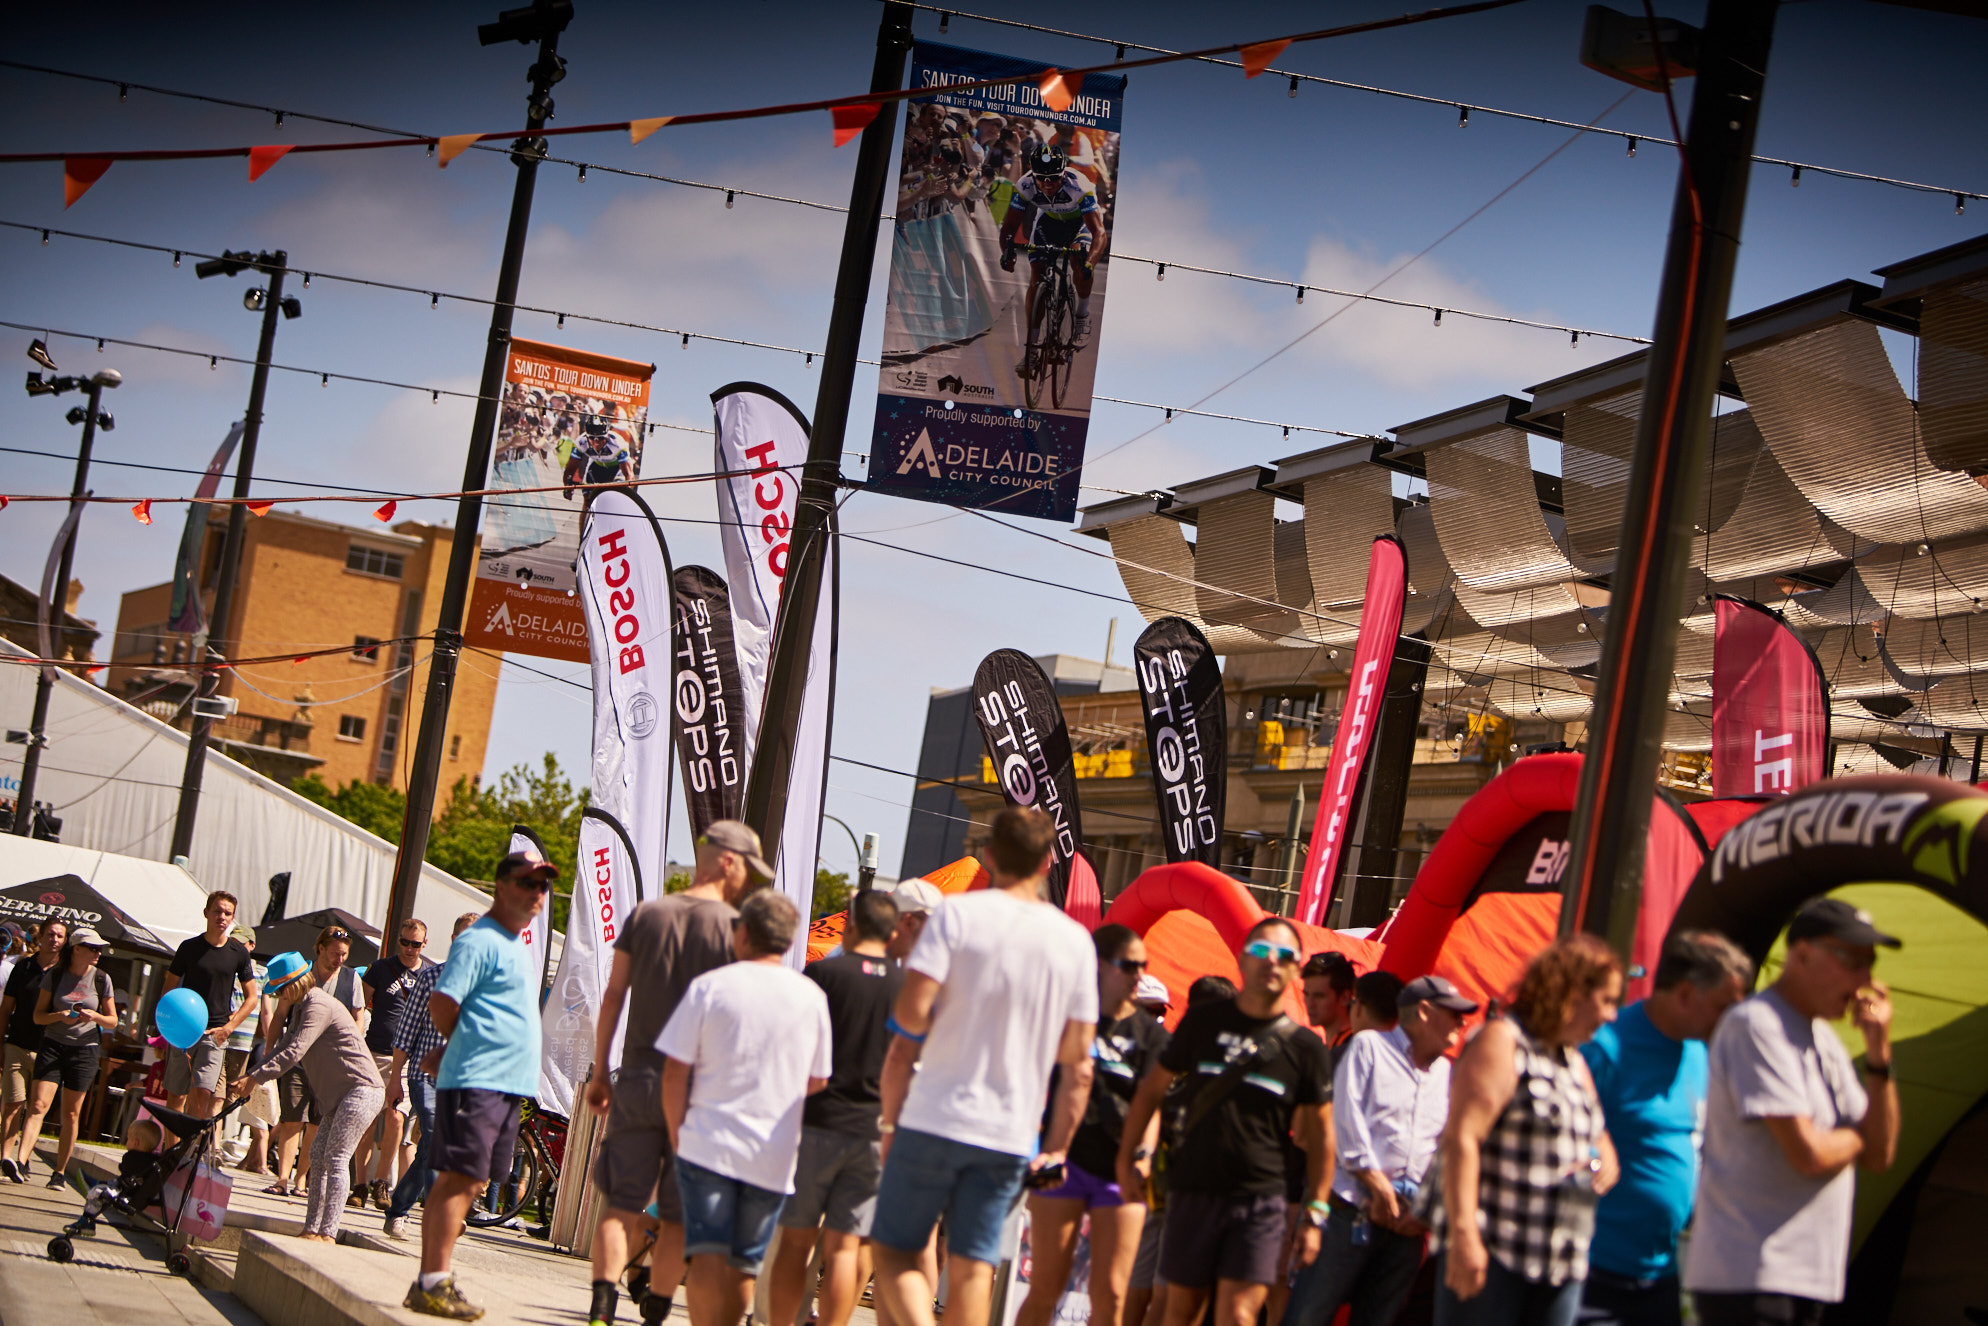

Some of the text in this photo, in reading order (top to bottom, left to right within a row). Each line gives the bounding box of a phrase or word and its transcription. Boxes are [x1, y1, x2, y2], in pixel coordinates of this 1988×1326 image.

[921, 69, 975, 96] SANTOS
[980, 78, 1016, 103] TOUR
[935, 94, 1097, 127] JOIN THE FUN. VISIT TOURDOWNUNDER.COM.AU
[513, 358, 642, 398] SANTOS TOUR DOWN UNDER
[963, 384, 994, 396] SOUTH
[925, 405, 1041, 431] Proudly supported by
[896, 426, 1059, 479] ADELAIDE
[949, 471, 1055, 491] CITY COUNCIL
[533, 574, 555, 582] SOUTH
[505, 587, 534, 601] Proudly
[536, 594, 574, 607] supported
[484, 600, 589, 638] ADELAID
[519, 631, 543, 641] CITY
[690, 598, 738, 786] SHIMANO
[1167, 649, 1216, 845] SHIMANO
[1003, 680, 1075, 858] SHIMANO
[1711, 792, 1930, 885] MERIDA
